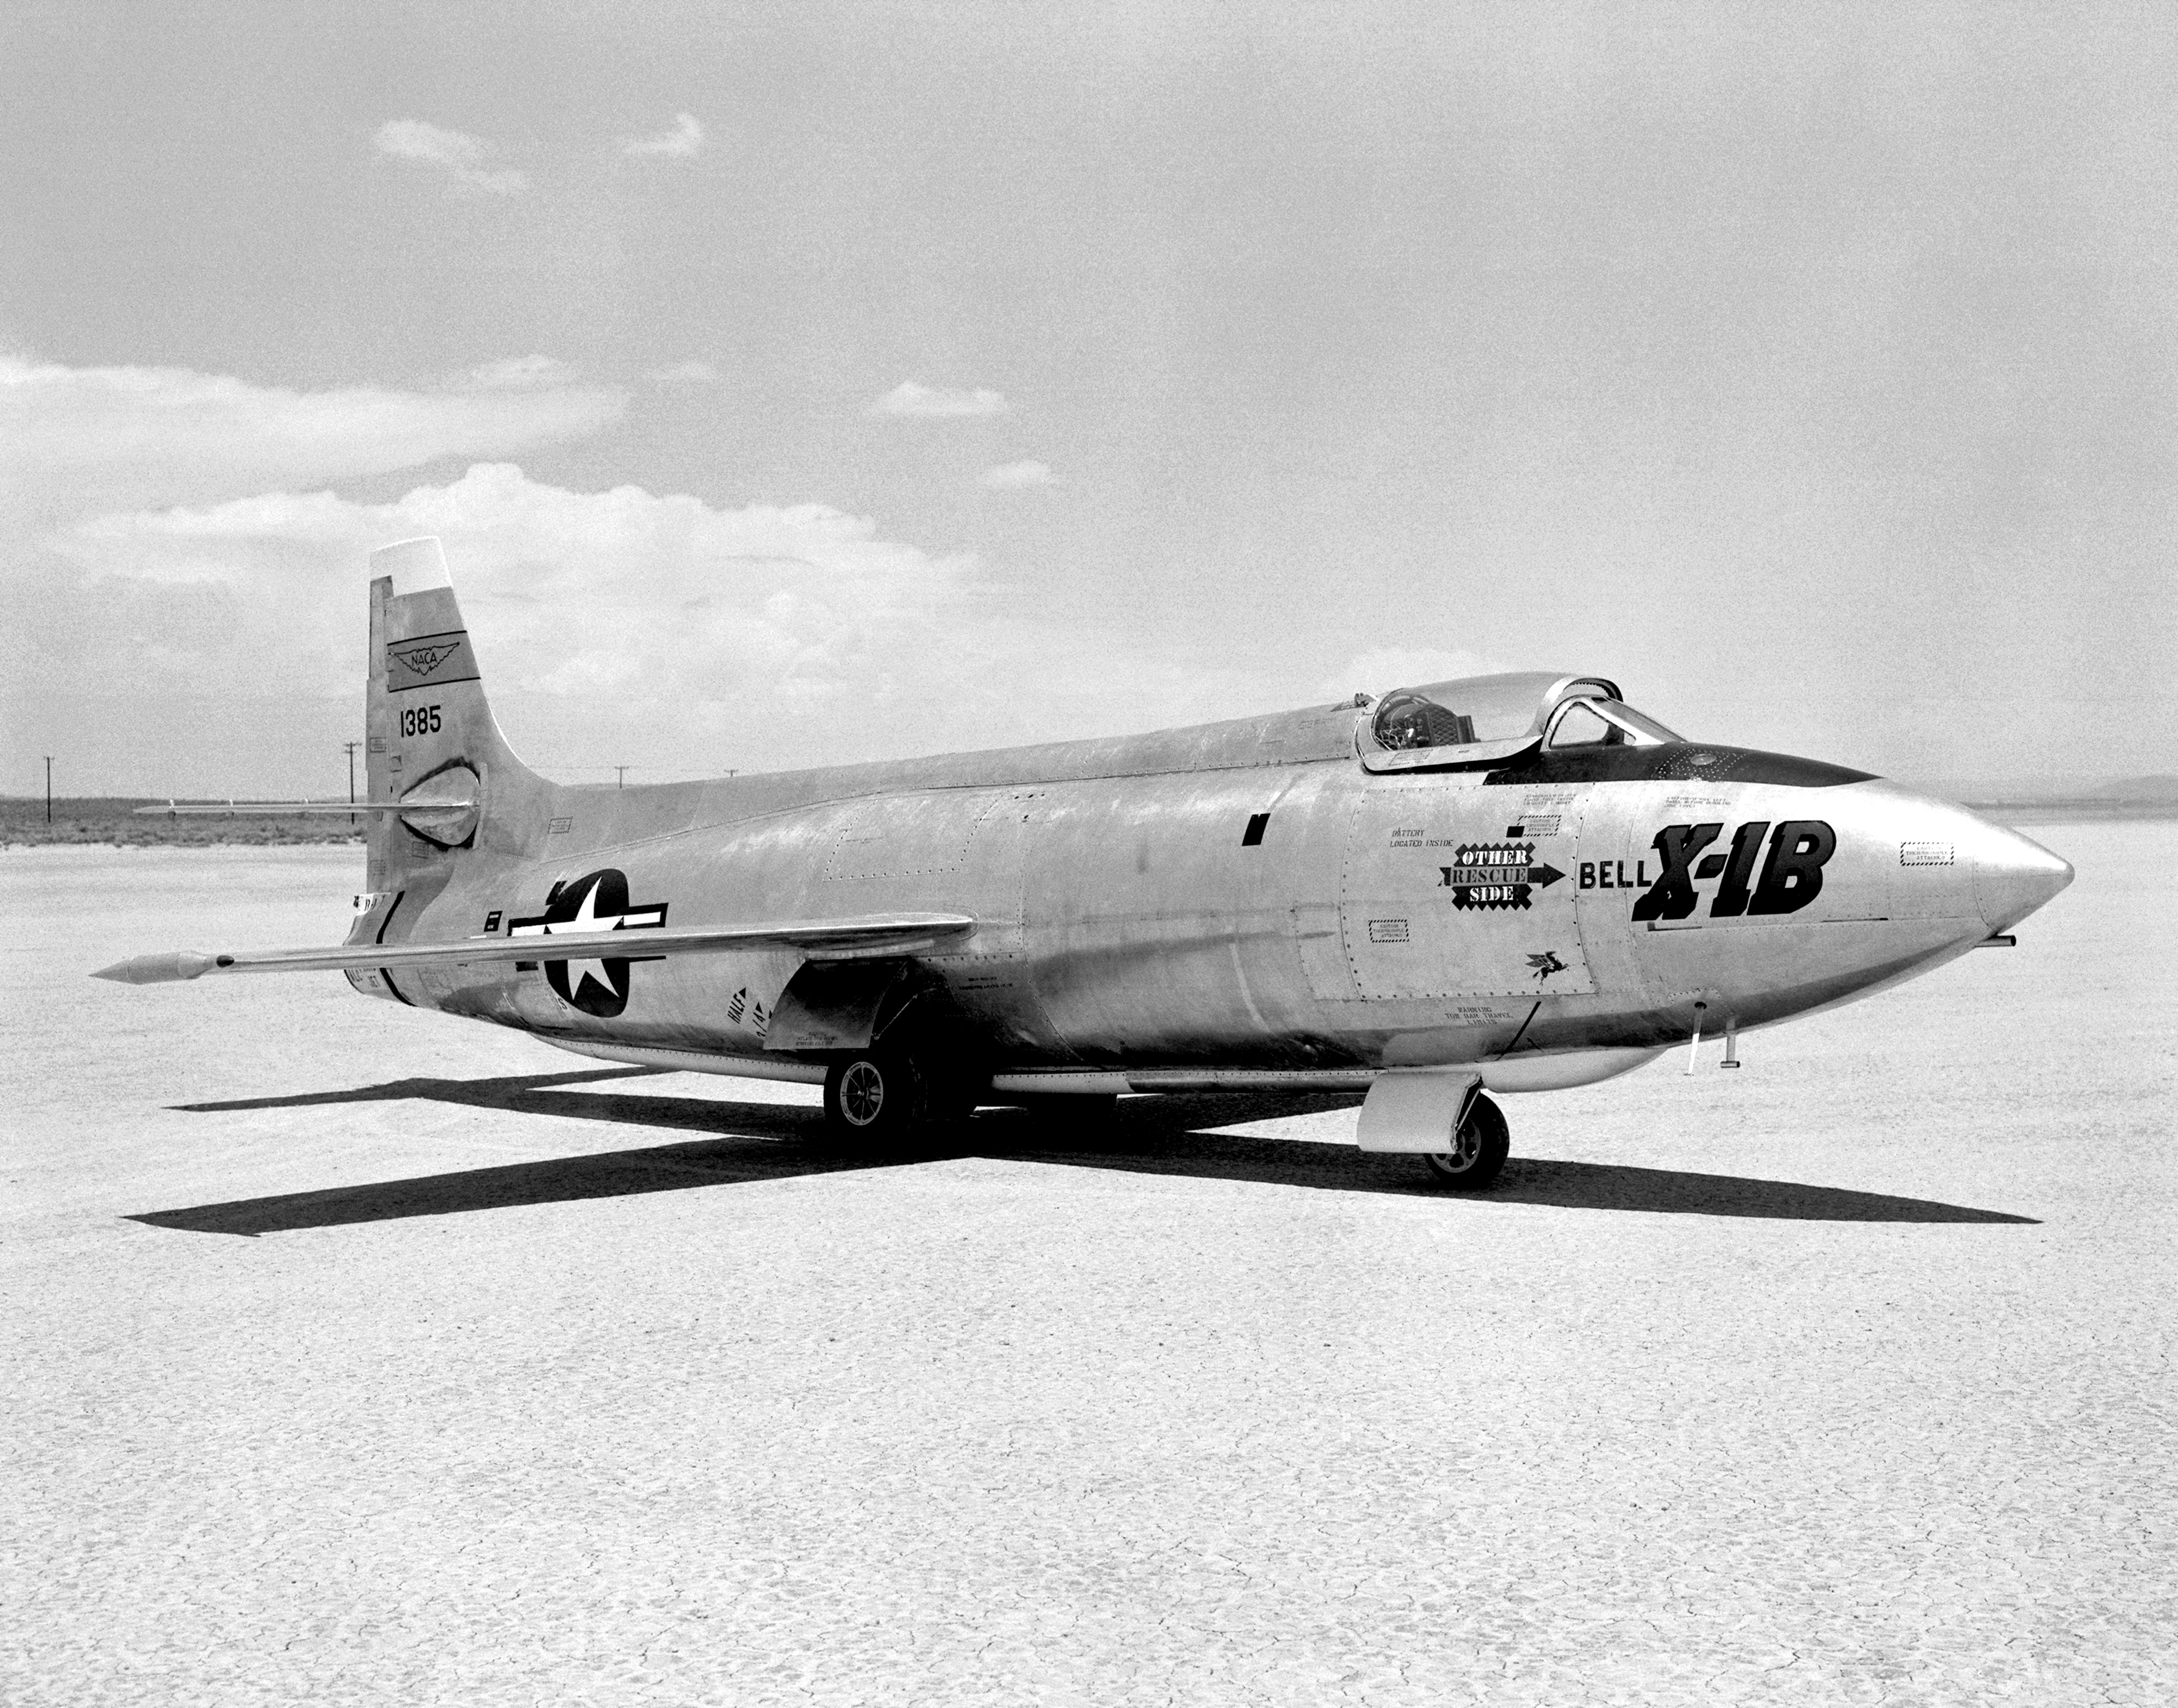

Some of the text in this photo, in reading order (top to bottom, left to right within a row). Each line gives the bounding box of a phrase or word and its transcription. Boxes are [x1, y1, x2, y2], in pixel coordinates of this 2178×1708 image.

[412, 652, 437, 667] NACA
[401, 705, 441, 737] 1385
[1392, 828, 1425, 837] BATTERY
[1426, 839, 1454, 847] INSIDE
[1462, 849, 1528, 866] OTHER
[1452, 868, 1527, 883] RESCUE
[1580, 860, 1652, 889] BELL
[1631, 820, 1837, 921] X-1B
[1470, 886, 1514, 902] SIDE
[727, 993, 745, 1024] HALF
